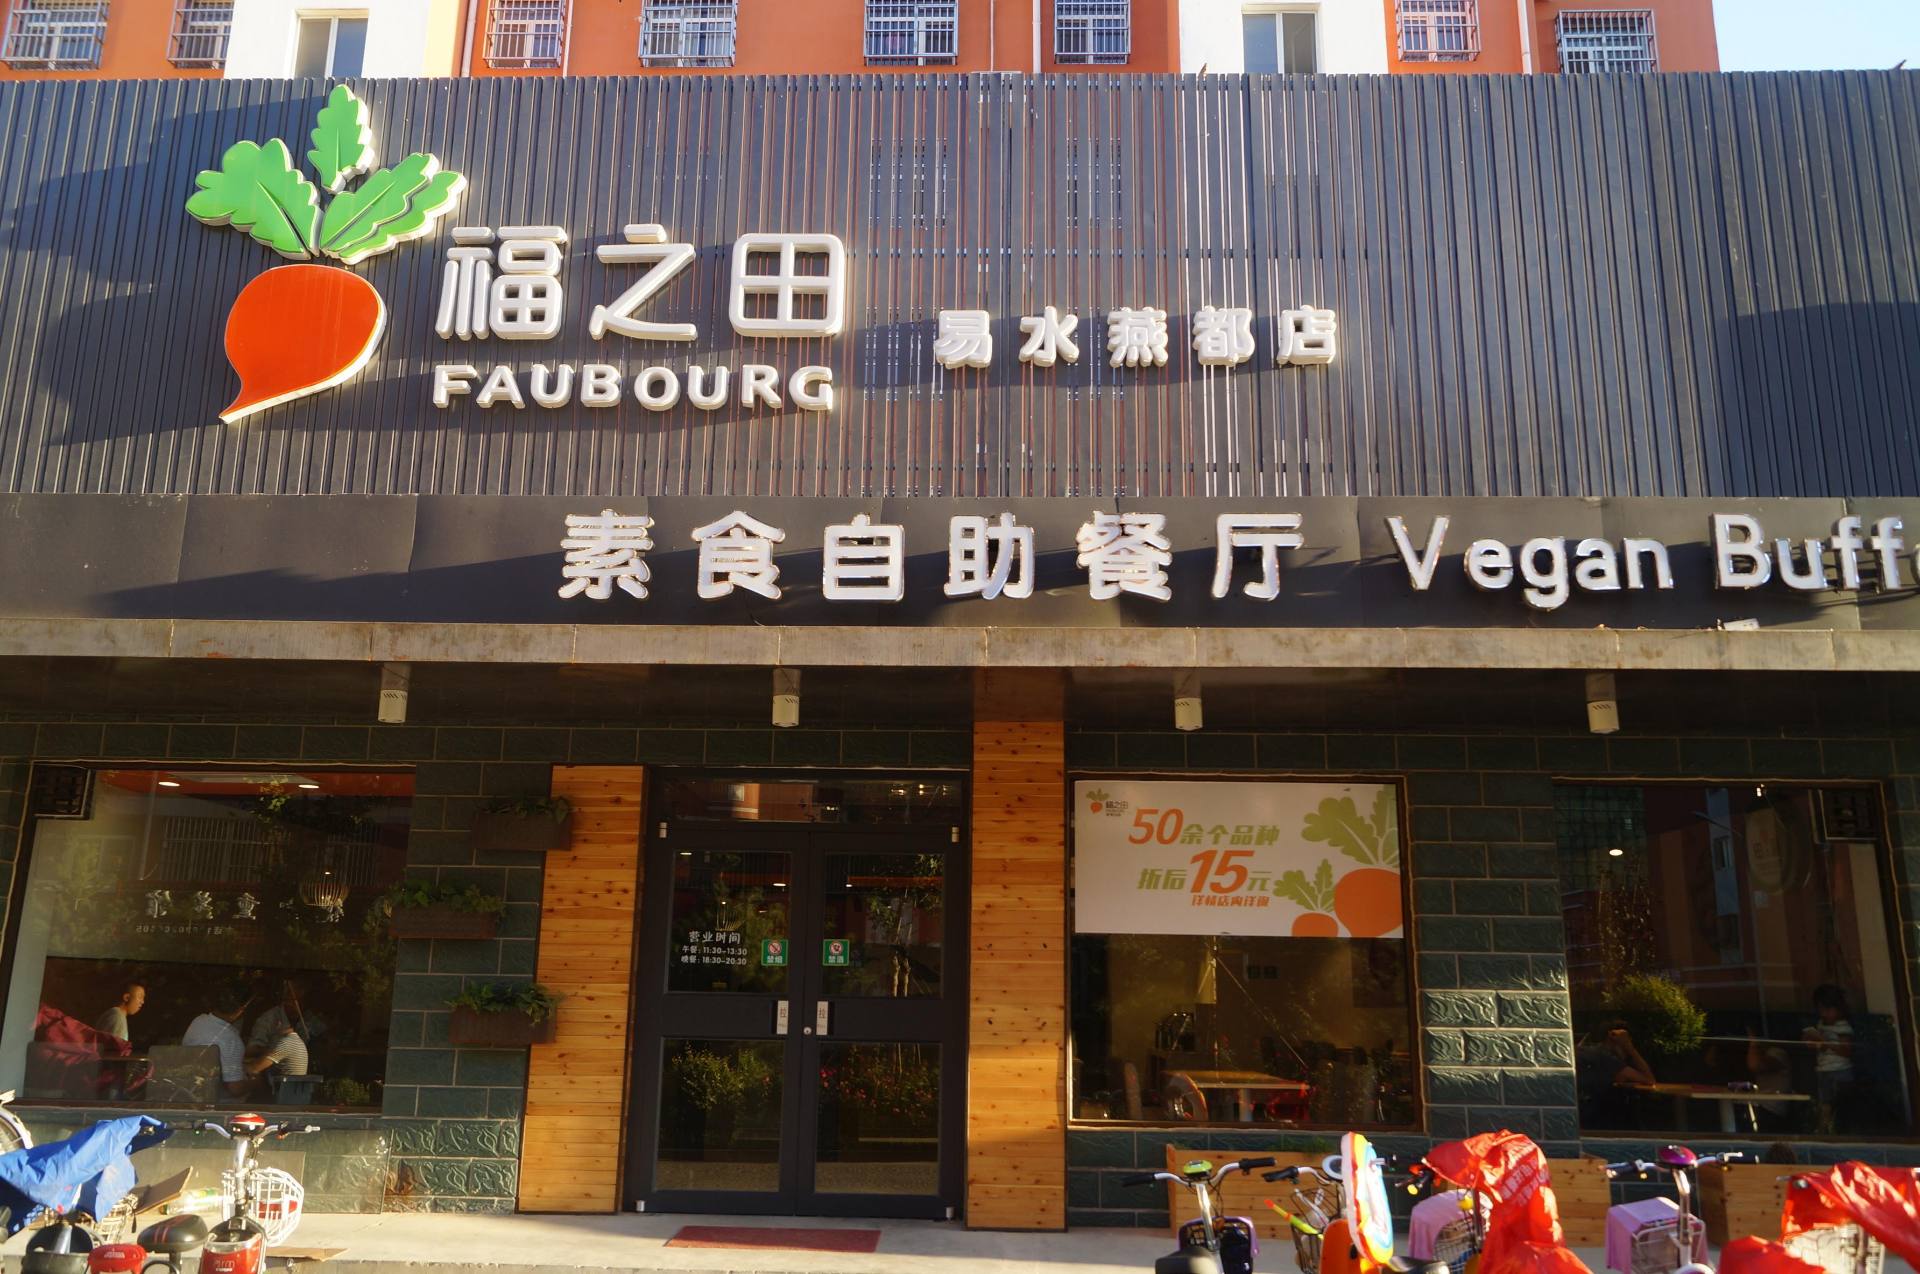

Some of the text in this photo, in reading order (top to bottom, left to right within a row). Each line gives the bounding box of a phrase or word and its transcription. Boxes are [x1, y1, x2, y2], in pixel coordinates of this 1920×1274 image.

[435, 223, 845, 340] 福之田
[934, 305, 1337, 369] 易水燕都店
[432, 363, 834, 412] FAUBOURG
[557, 508, 1920, 612] 素食自助餐厅 Vegan Buff
[1128, 808, 1281, 846] 50余个品种
[688, 930, 741, 945] 营业时间
